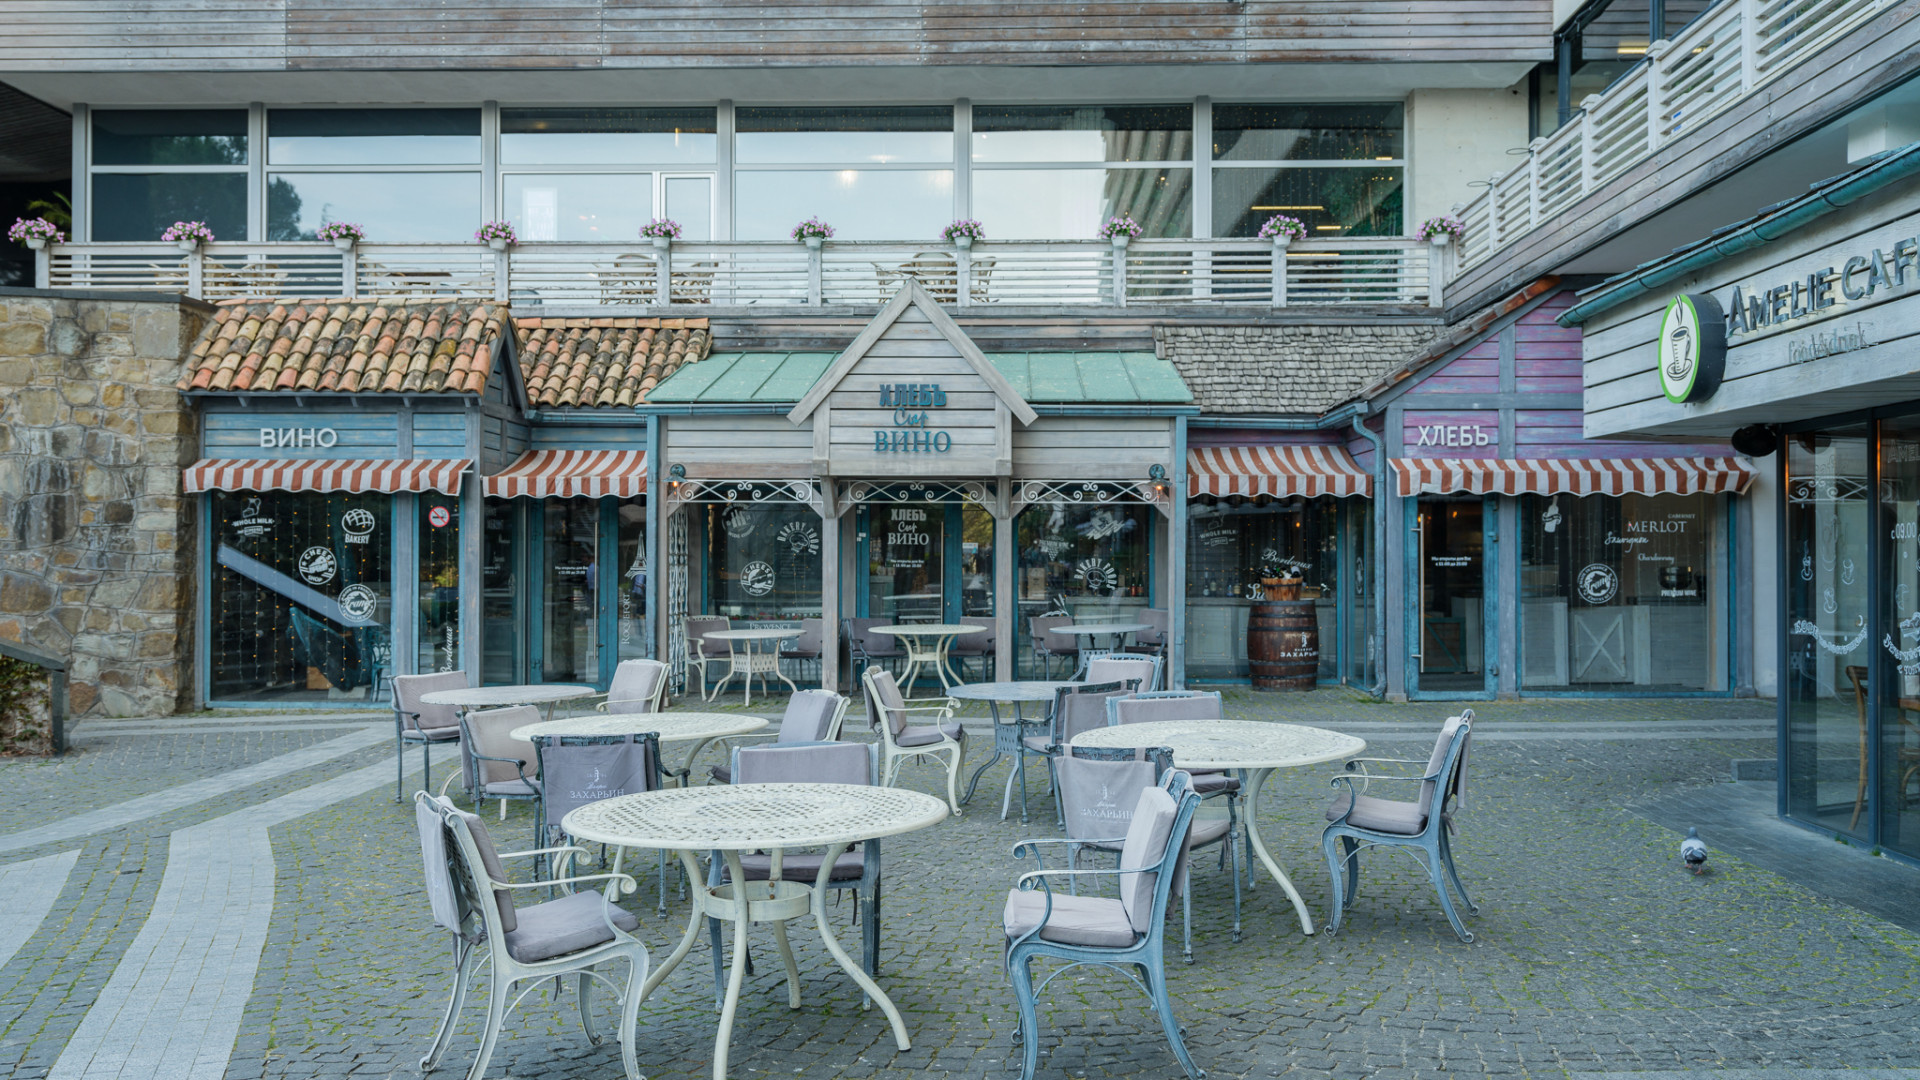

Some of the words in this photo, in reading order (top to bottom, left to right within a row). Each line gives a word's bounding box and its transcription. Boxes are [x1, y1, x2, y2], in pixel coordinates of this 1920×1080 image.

[1725, 266, 1835, 338] AMELIE
[1842, 233, 1920, 300] CAF
[879, 383, 947, 406] ХЛЕБЪ
[893, 407, 928, 428] Сыр
[259, 428, 338, 448] ВИНО
[874, 430, 951, 452] ВИНО
[1417, 425, 1489, 447] ХЛЕБЪ
[891, 508, 927, 521] ХЛЕБЪ
[777, 521, 806, 542] BAKERY
[898, 521, 918, 536] Сыр
[1199, 530, 1220, 539] WHOLE
[1627, 521, 1687, 533] MERLOT
[1895, 522, 1917, 539] 09.00
[345, 533, 370, 544] BAKERY
[887, 532, 929, 545] ВИНО
[304, 548, 334, 566] CHEESE
[1261, 548, 1313, 569] Bordeaux
[745, 564, 772, 579] CHEESE
[1074, 558, 1102, 580] BAKERY
[569, 788, 625, 799] ЗАХАРЬИН
